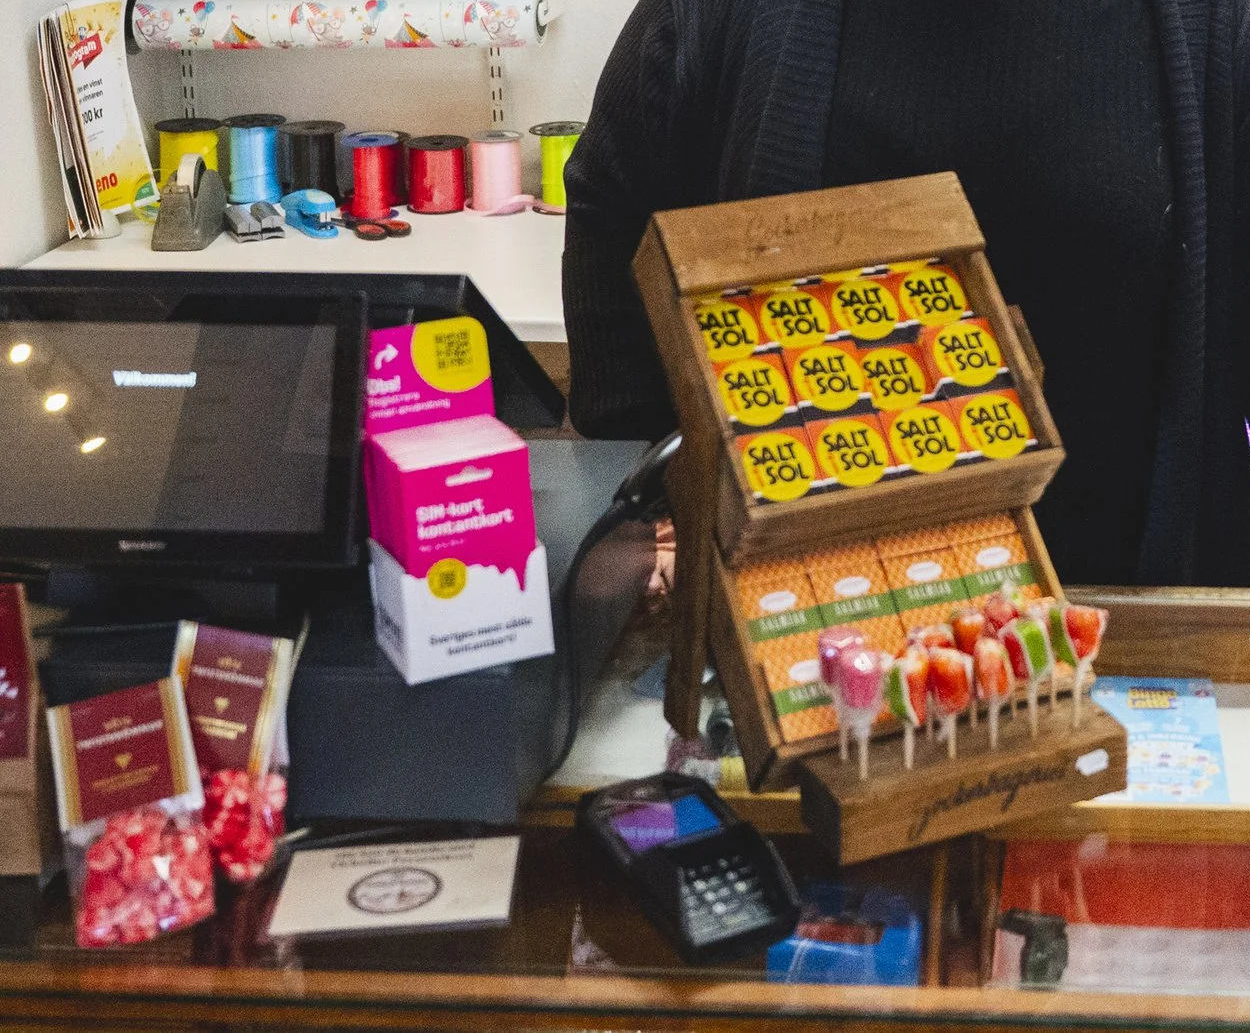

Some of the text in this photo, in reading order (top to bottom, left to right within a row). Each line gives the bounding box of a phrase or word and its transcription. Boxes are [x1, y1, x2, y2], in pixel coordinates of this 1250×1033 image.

[837, 286, 883, 309] SALT
[904, 276, 951, 298] SALT
[767, 296, 812, 318] SALT
[854, 303, 895, 324] SOL
[921, 292, 962, 315] SOL
[783, 315, 825, 336] SOL
[939, 330, 984, 353] SALT
[801, 352, 845, 376] SALT
[955, 347, 997, 369] SOL
[724, 368, 771, 391] SALT
[817, 370, 859, 392] SOL
[742, 387, 785, 408] SOL
[965, 401, 1011, 425] SALT
[896, 415, 942, 439] SALT
[983, 420, 1025, 442] SOL
[823, 429, 870, 454] SALT
[914, 434, 956, 455] SOL
[842, 447, 884, 469] SOL
